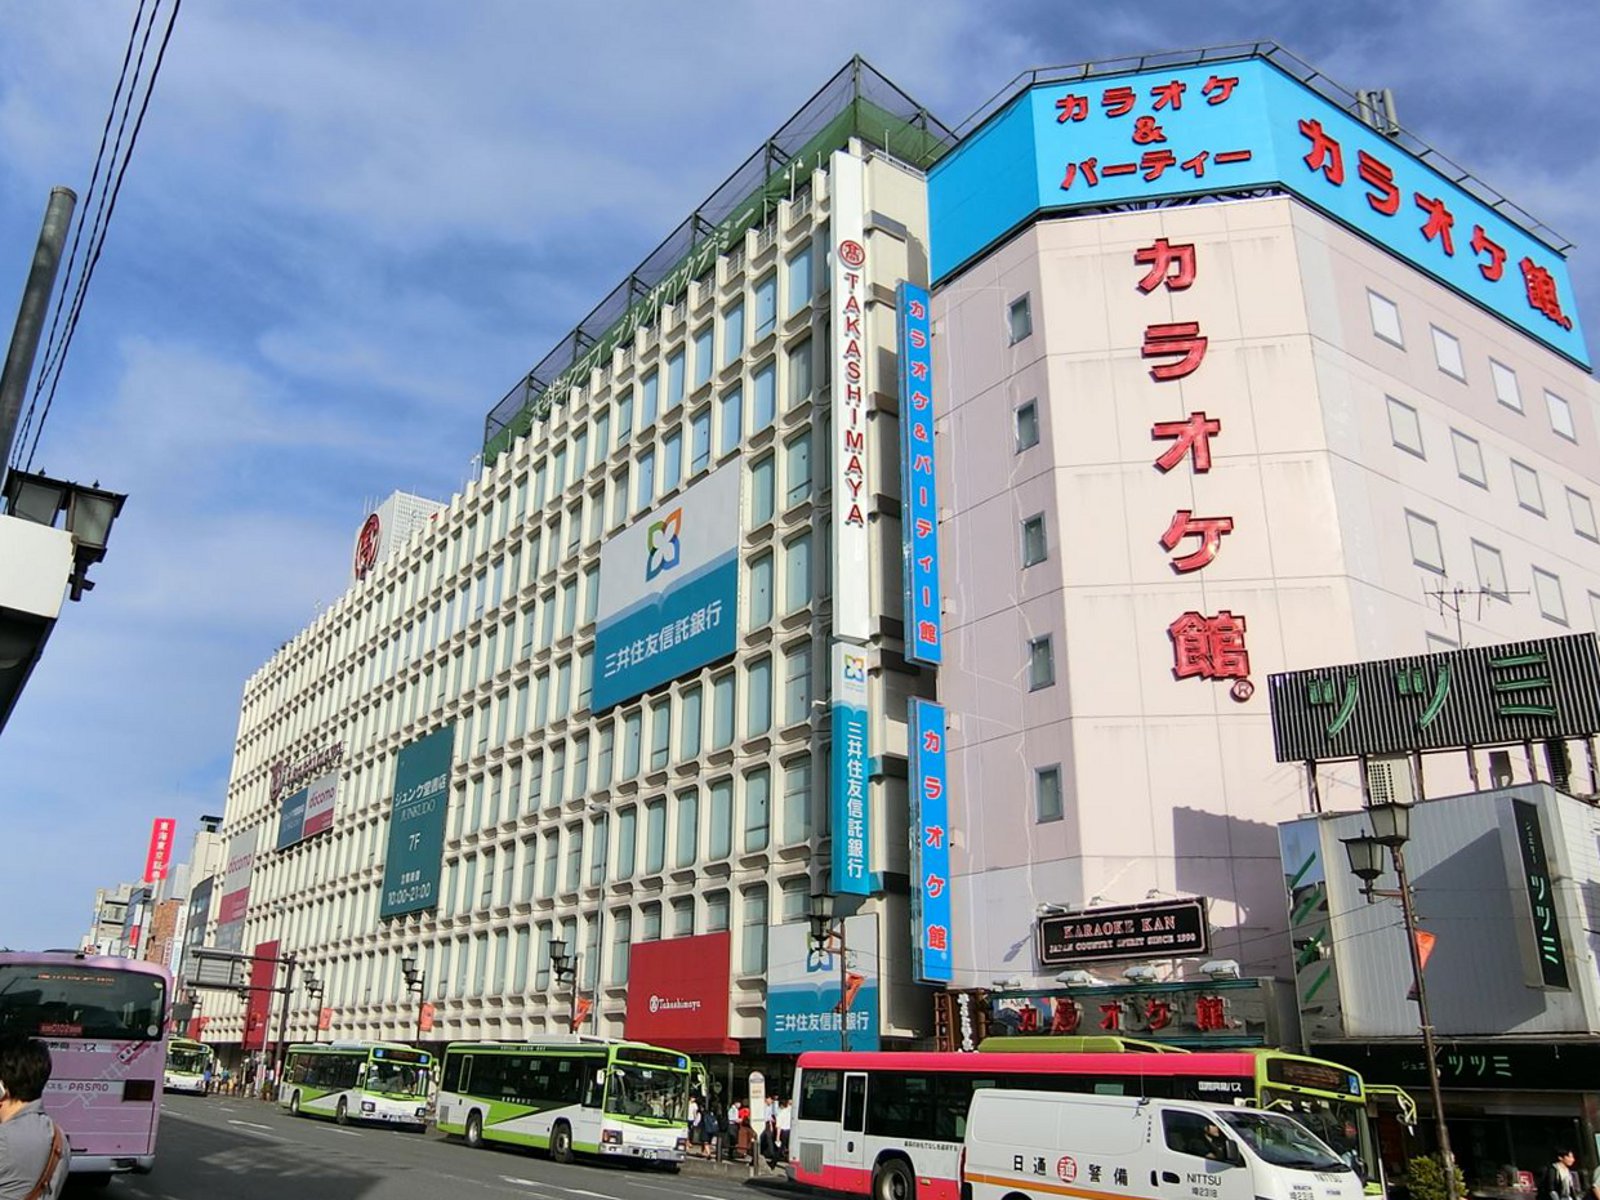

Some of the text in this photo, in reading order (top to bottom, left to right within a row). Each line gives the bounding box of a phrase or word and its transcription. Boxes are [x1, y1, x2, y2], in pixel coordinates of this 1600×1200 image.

[1056, 75, 1239, 122] カラオケ
[1133, 116, 1167, 145] &
[1061, 149, 1252, 191] パーティー
[1300, 118, 1564, 327] カラオケ館
[844, 273, 864, 528] TAKASHIMAYA
[1134, 238, 1252, 681] カラオケ館
[604, 600, 722, 678] 三井住友信託銀行
[1307, 652, 1558, 739] ツツミ
[395, 773, 447, 808] ジュンク堂書店
[847, 722, 865, 880] 三井住友信託銀行
[408, 832, 421, 851] 7F
[923, 730, 947, 950] カラオケ館
[1063, 915, 1176, 939] KARAOKE KAN
[1531, 875, 1559, 965] ツツミ
[1147, 935, 1174, 945] SINCE
[659, 998, 701, 1011] Takashimaya
[1018, 995, 1226, 1033] カラオケ館
[1448, 1055, 1512, 1076] ツツミ
[69, 1082, 109, 1092] PASMO
[1013, 1154, 1046, 1176] 日通
[1088, 1163, 1128, 1187] 警備
[1187, 1174, 1222, 1187] NITTSU
